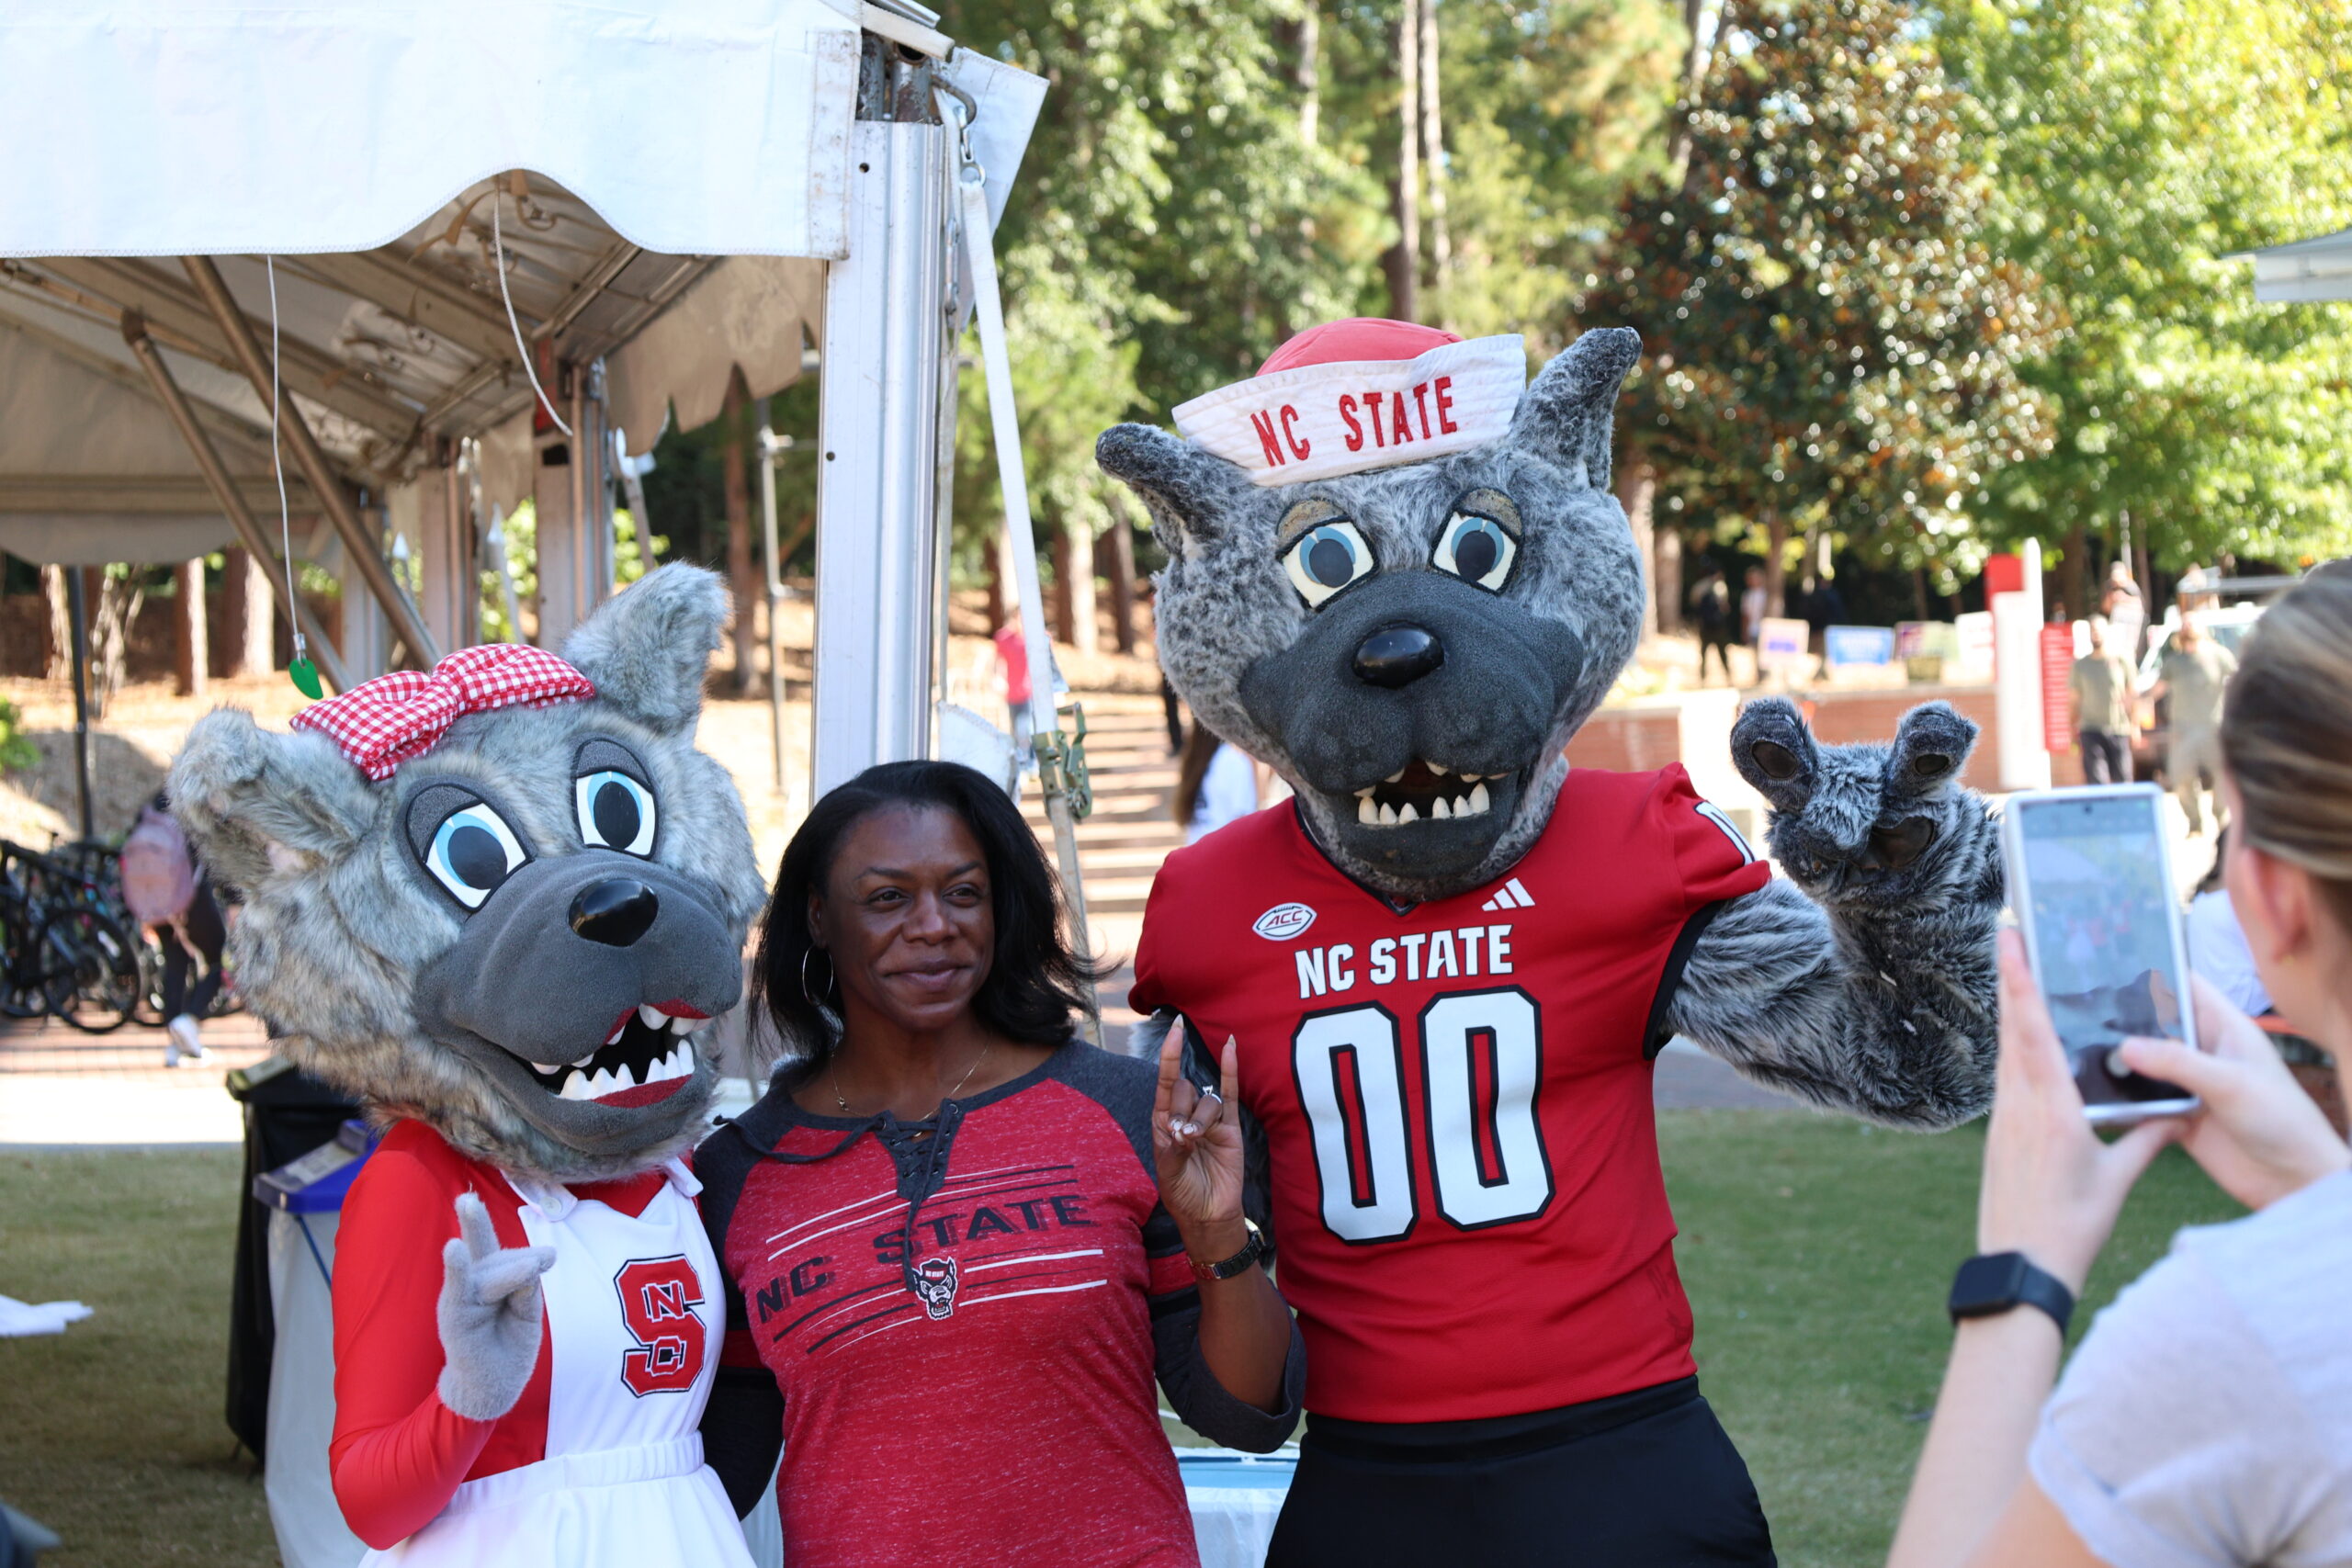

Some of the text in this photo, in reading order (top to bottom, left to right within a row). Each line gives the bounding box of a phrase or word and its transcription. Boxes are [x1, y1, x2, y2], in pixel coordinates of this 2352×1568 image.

[1250, 376, 1457, 467] NC STATE
[1265, 910, 1304, 927] ACC
[1295, 924, 1514, 999] NC STATE
[1290, 984, 1556, 1246] 00
[756, 1194, 1094, 1324] NC STATE
